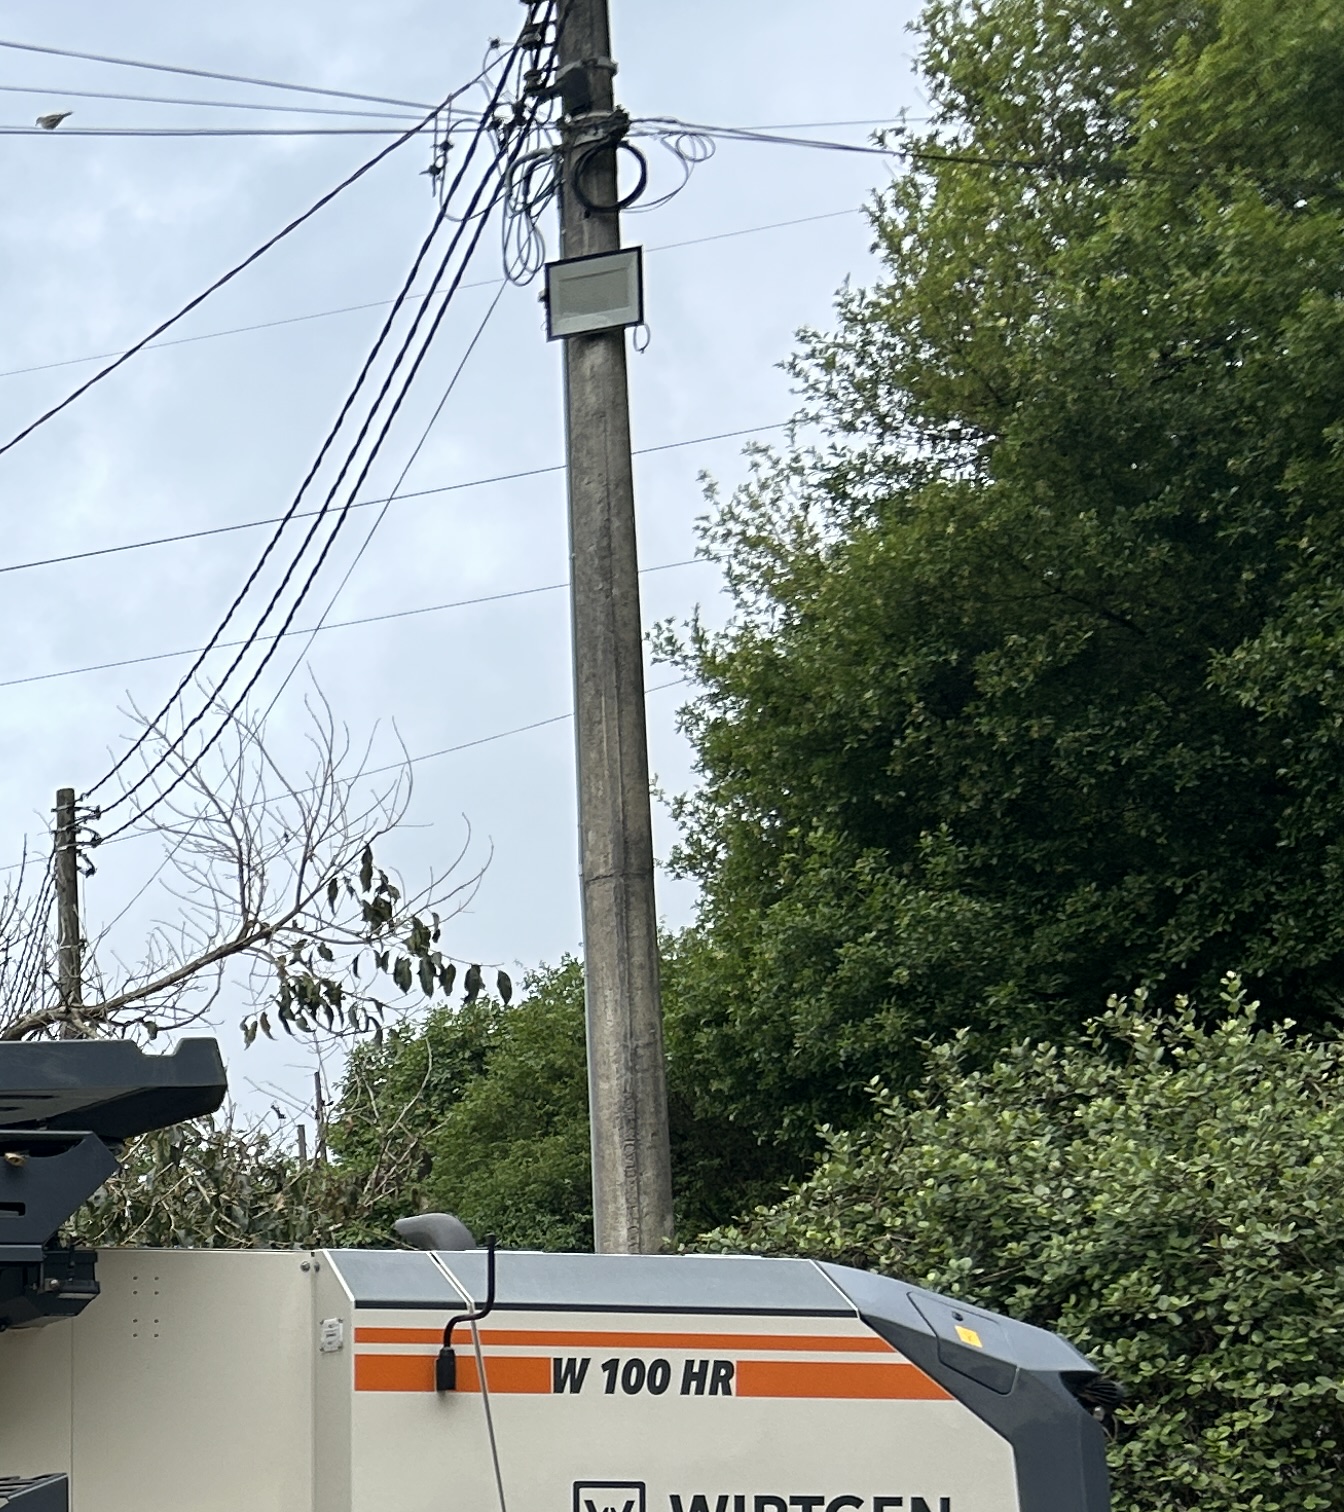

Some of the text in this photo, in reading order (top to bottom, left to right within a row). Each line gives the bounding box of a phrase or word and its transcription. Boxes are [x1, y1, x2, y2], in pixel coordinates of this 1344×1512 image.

[553, 1357, 735, 1396] W 100 HR
